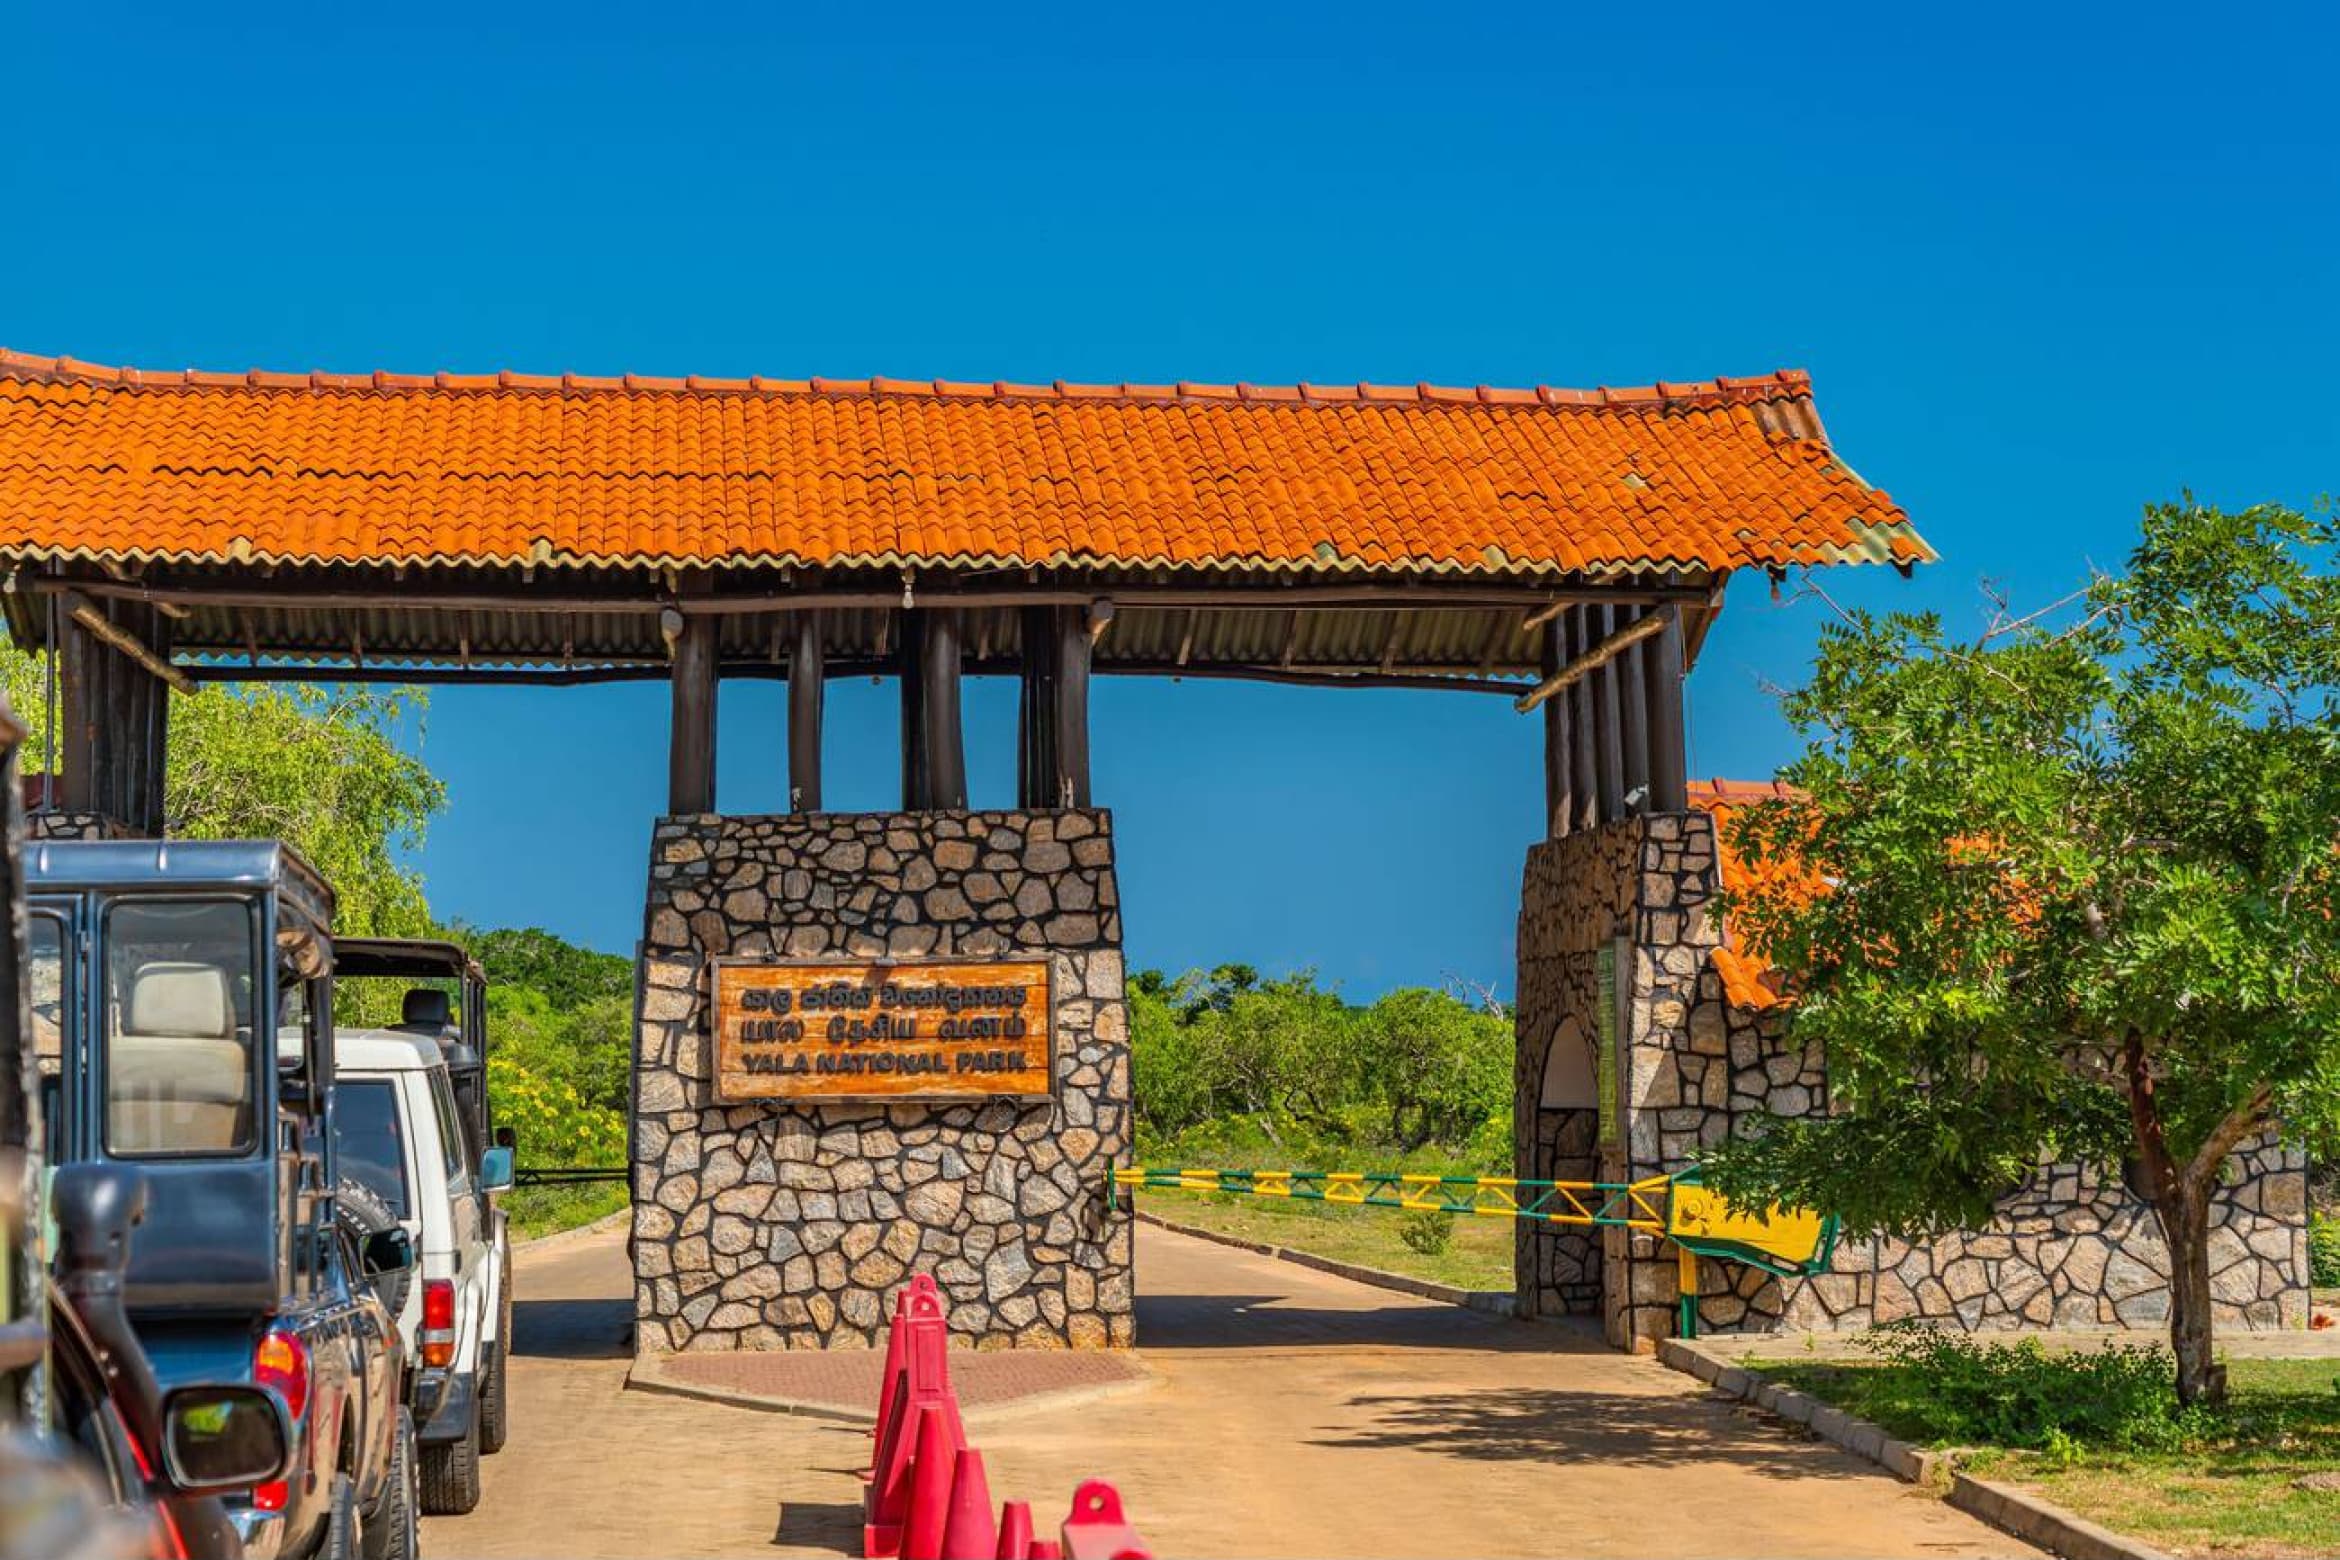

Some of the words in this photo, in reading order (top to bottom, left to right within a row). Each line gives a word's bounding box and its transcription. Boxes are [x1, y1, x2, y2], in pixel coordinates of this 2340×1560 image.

[741, 1053, 809, 1075] YALA
[816, 1052, 949, 1075] NATIONAL
[956, 1051, 1027, 1074] PARK
